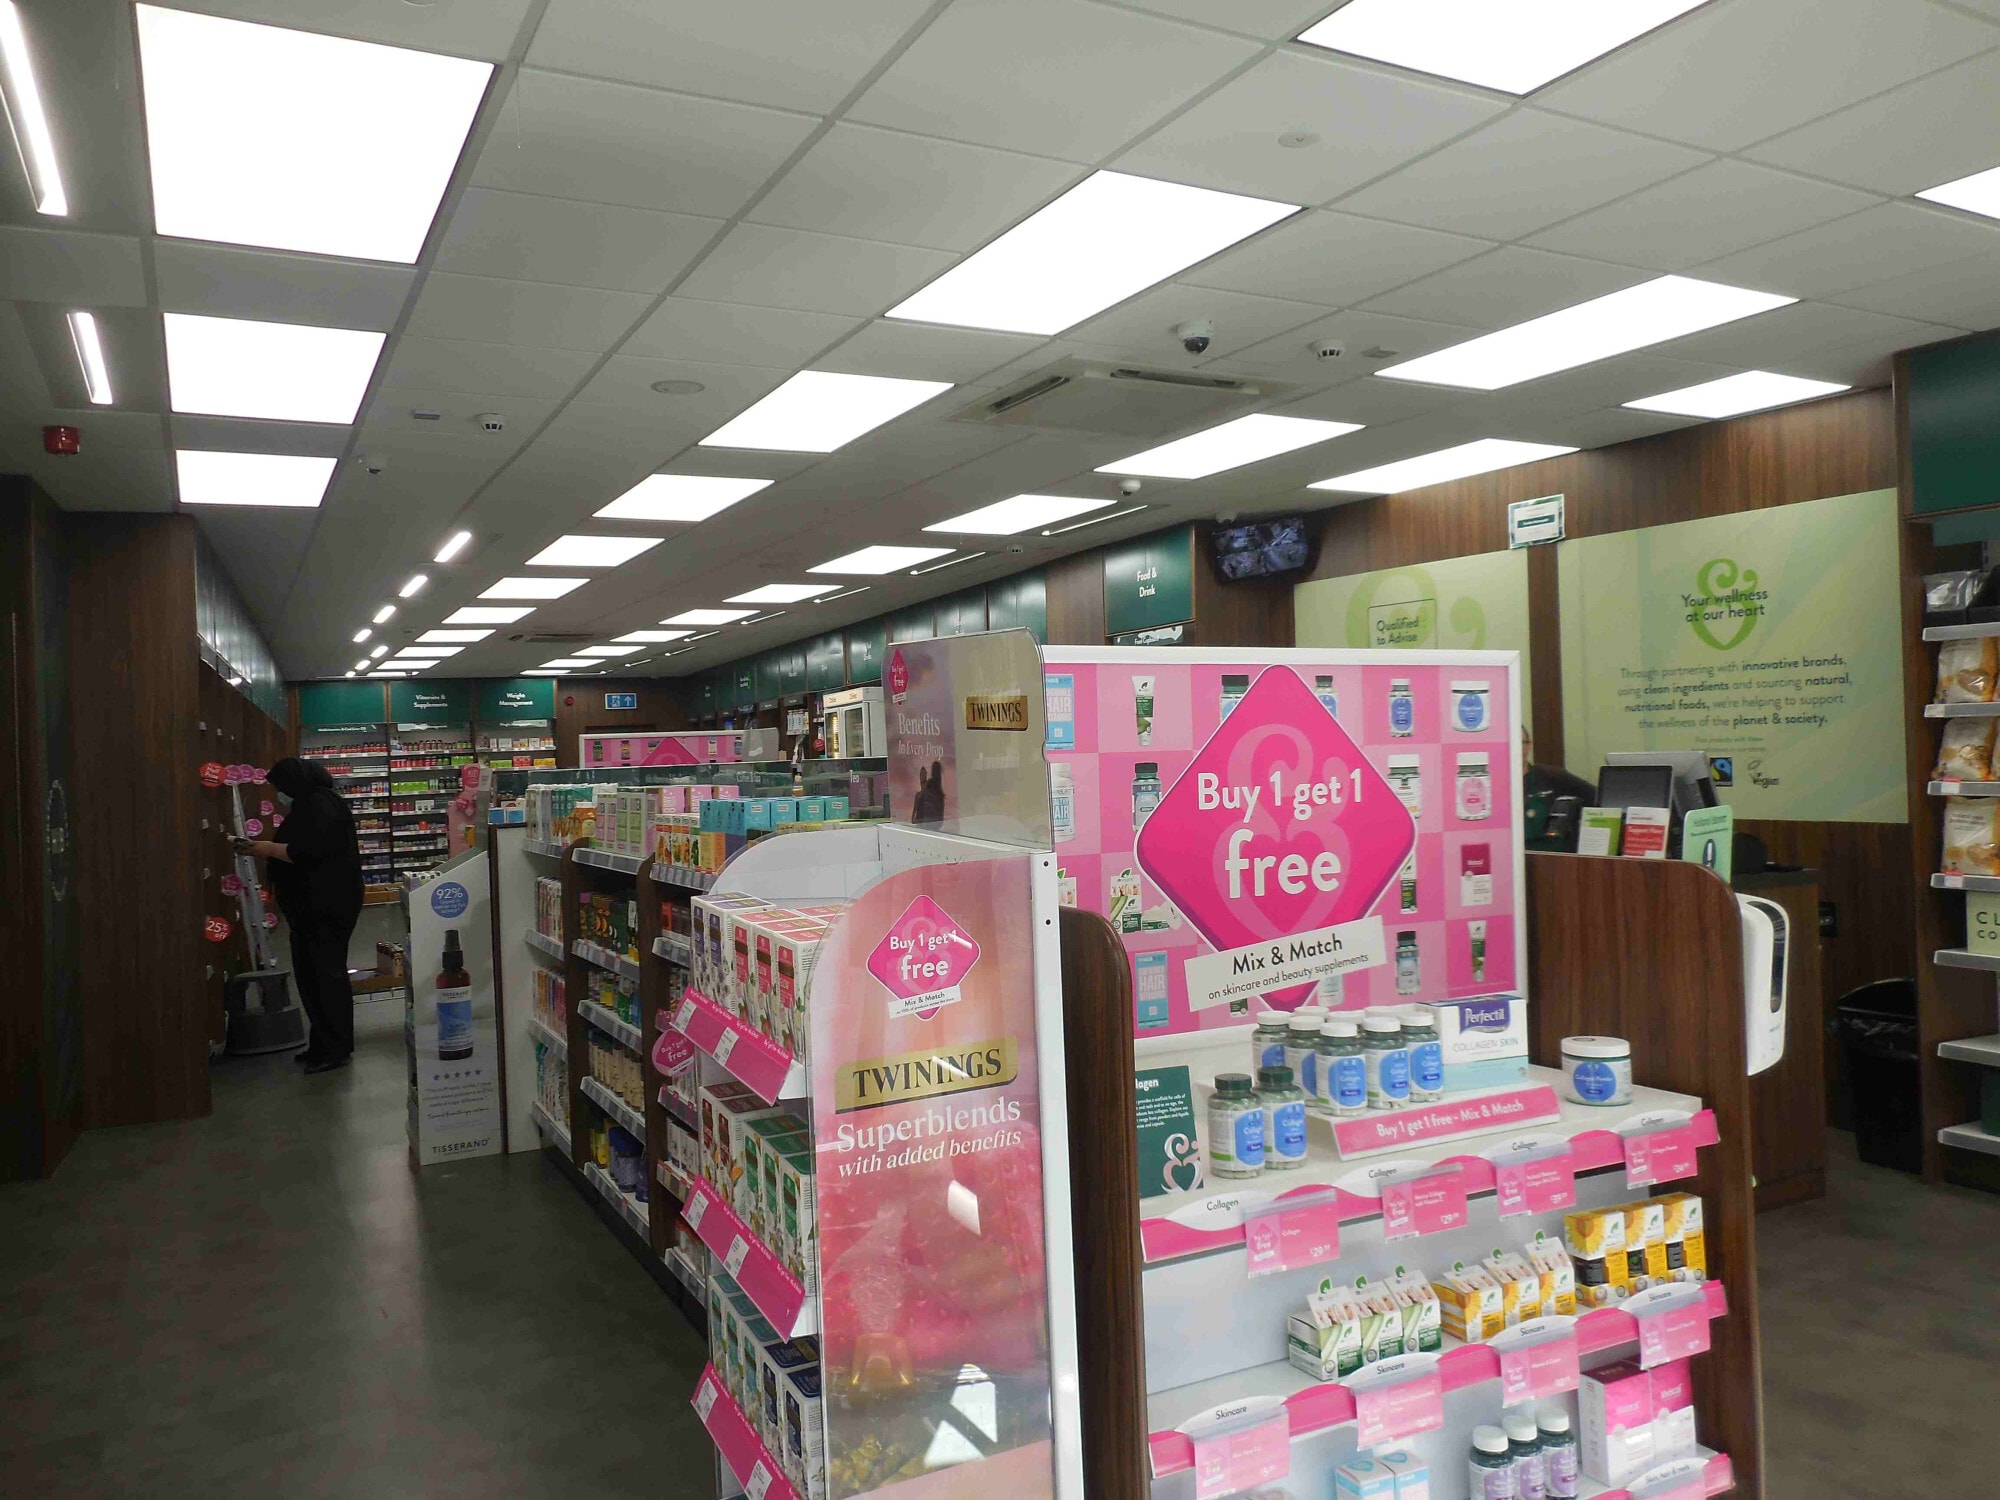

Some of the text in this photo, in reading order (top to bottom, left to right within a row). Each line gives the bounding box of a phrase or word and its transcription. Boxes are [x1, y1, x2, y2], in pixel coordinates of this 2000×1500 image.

[1137, 567, 1157, 581] Food &
[1139, 584, 1156, 598] Drink
[1681, 589, 1768, 608] Your wellness
[1685, 604, 1765, 622] at our heart
[1377, 615, 1419, 634] Qualified
[1377, 631, 1417, 645] to Advise
[1620, 667, 1660, 681] Through
[1662, 664, 1714, 679] partnering
[1717, 661, 1739, 673] with
[1742, 657, 1799, 671] innovative
[1617, 673, 1852, 699] using clean ingredients and sourcing natural,
[413, 701, 448, 709] Supplements
[499, 700, 533, 708] Management
[1624, 694, 1844, 712] nutritional foods, we're helping to support
[970, 702, 1022, 723] TWININGS
[898, 713, 940, 736] Benefits
[1639, 712, 1828, 729] the wellness of the planet & society.
[898, 740, 944, 758] In Every Drop
[1752, 772, 1779, 788] Vegan
[1197, 768, 1361, 823] Buy 1 get 1
[1055, 805, 1069, 819] AIR
[1225, 828, 1341, 898] free
[436, 887, 463, 899] 92%
[205, 921, 228, 932] 25%
[890, 936, 915, 953] Buy
[918, 933, 924, 947] 1
[927, 934, 949, 951] get
[1233, 933, 1343, 975] Mix & Match
[901, 954, 948, 980] free
[1140, 975, 1165, 991] HAIR
[1208, 953, 1369, 1000] on skincare and beauty supplements
[904, 999, 916, 1007] Mix
[925, 992, 945, 1002] Match
[1464, 1008, 1505, 1024] Perfectil
[1453, 1038, 1518, 1053] COLLAGEN SKIN
[668, 1049, 687, 1062] free
[853, 1048, 1002, 1098] TWININGS
[1135, 1078, 1159, 1091] lagen
[837, 1096, 1021, 1153] Superblends
[1377, 1122, 1398, 1139] Buy
[1400, 1120, 1405, 1133] 1
[1408, 1119, 1423, 1136] get
[1424, 1117, 1429, 1129] 1
[1430, 1112, 1452, 1128] free
[1461, 1105, 1480, 1121] Mix
[1482, 1104, 1490, 1117] &
[1492, 1100, 1524, 1116] Match
[1641, 1117, 1664, 1128] Collagen
[432, 1140, 488, 1153] TISSERAND
[838, 1130, 1021, 1178] with added benefits
[1512, 1141, 1538, 1152] Collagen
[1368, 1167, 1397, 1180] Collagen
[1207, 1198, 1239, 1212] Collagen
[1391, 1206, 1405, 1216] free
[1257, 1240, 1271, 1250] free
[1649, 1291, 1671, 1302] Skincare
[1520, 1324, 1545, 1336] Skincare
[1377, 1362, 1405, 1375] Skincare
[1215, 1406, 1247, 1420] Skincare
